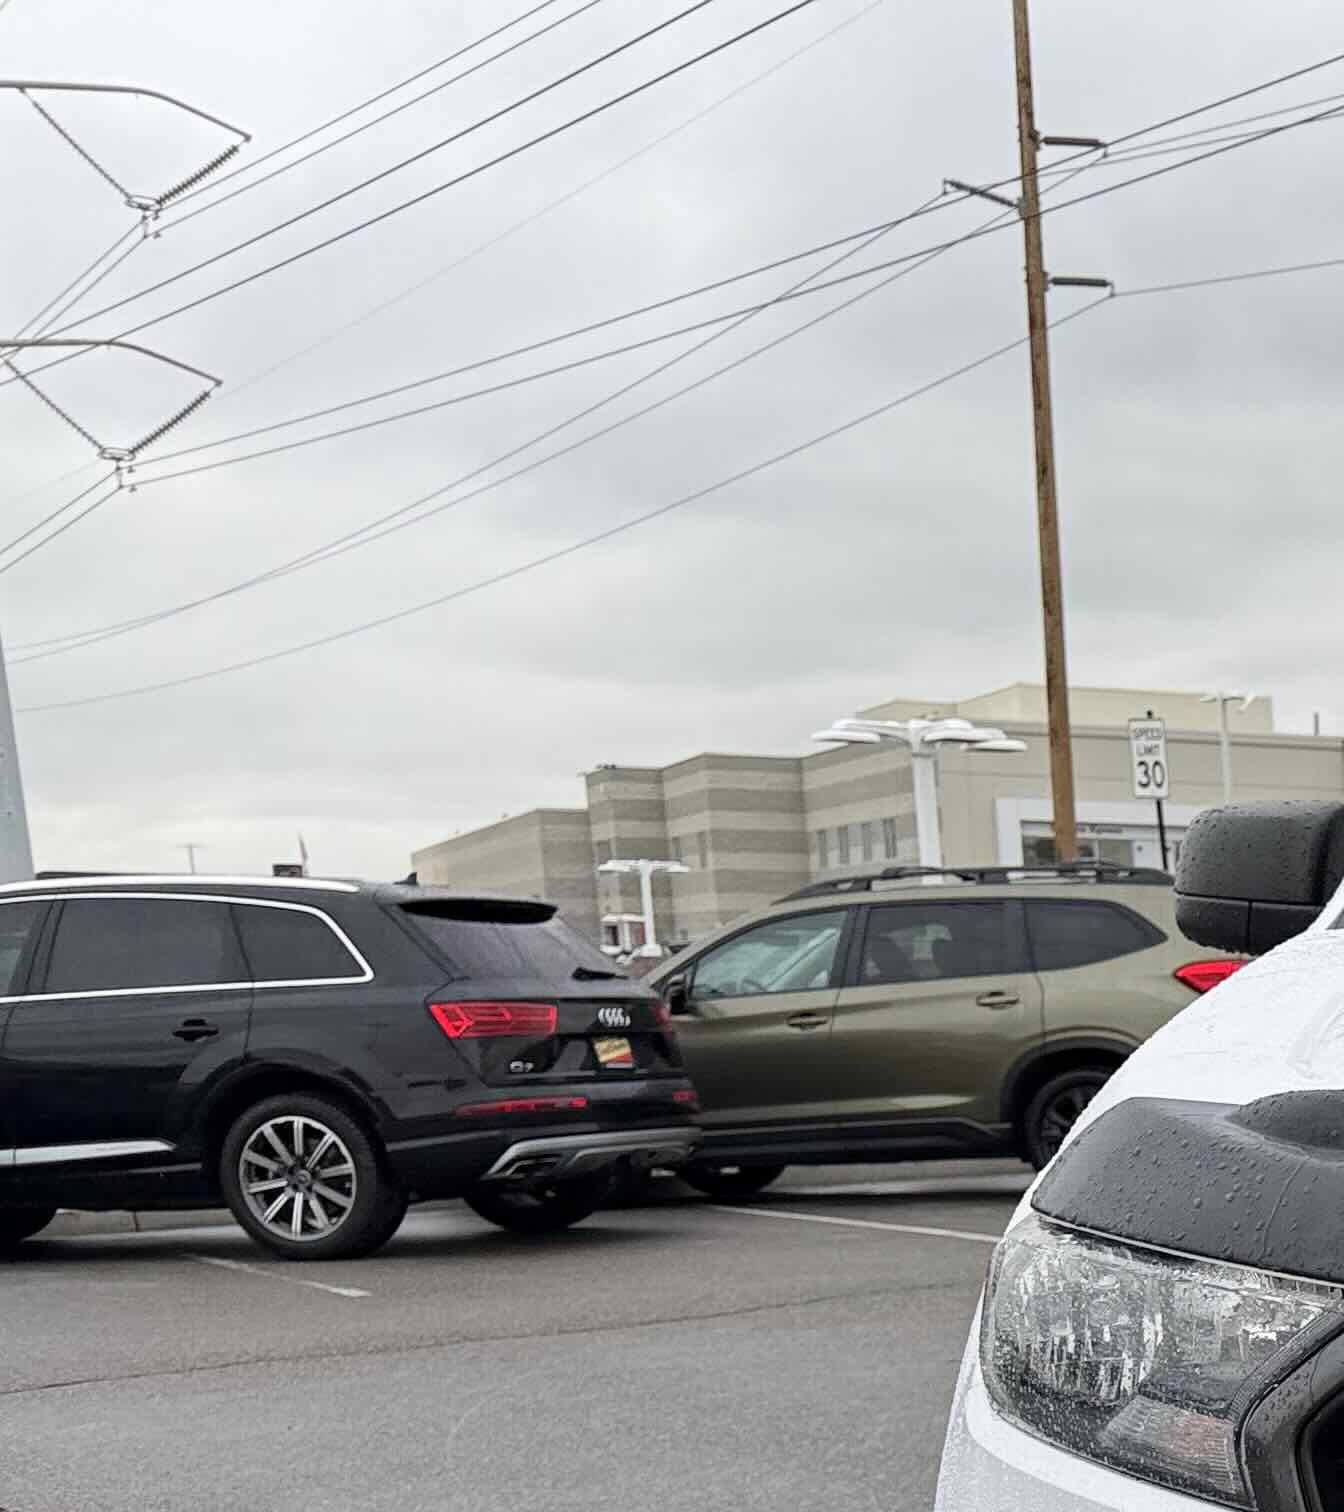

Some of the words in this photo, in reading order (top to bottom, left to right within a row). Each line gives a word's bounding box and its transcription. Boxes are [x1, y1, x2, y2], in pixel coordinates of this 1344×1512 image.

[1134, 727, 1163, 739] SPEED
[1135, 743, 1161, 757] LIMIT
[1137, 760, 1166, 788] 30
